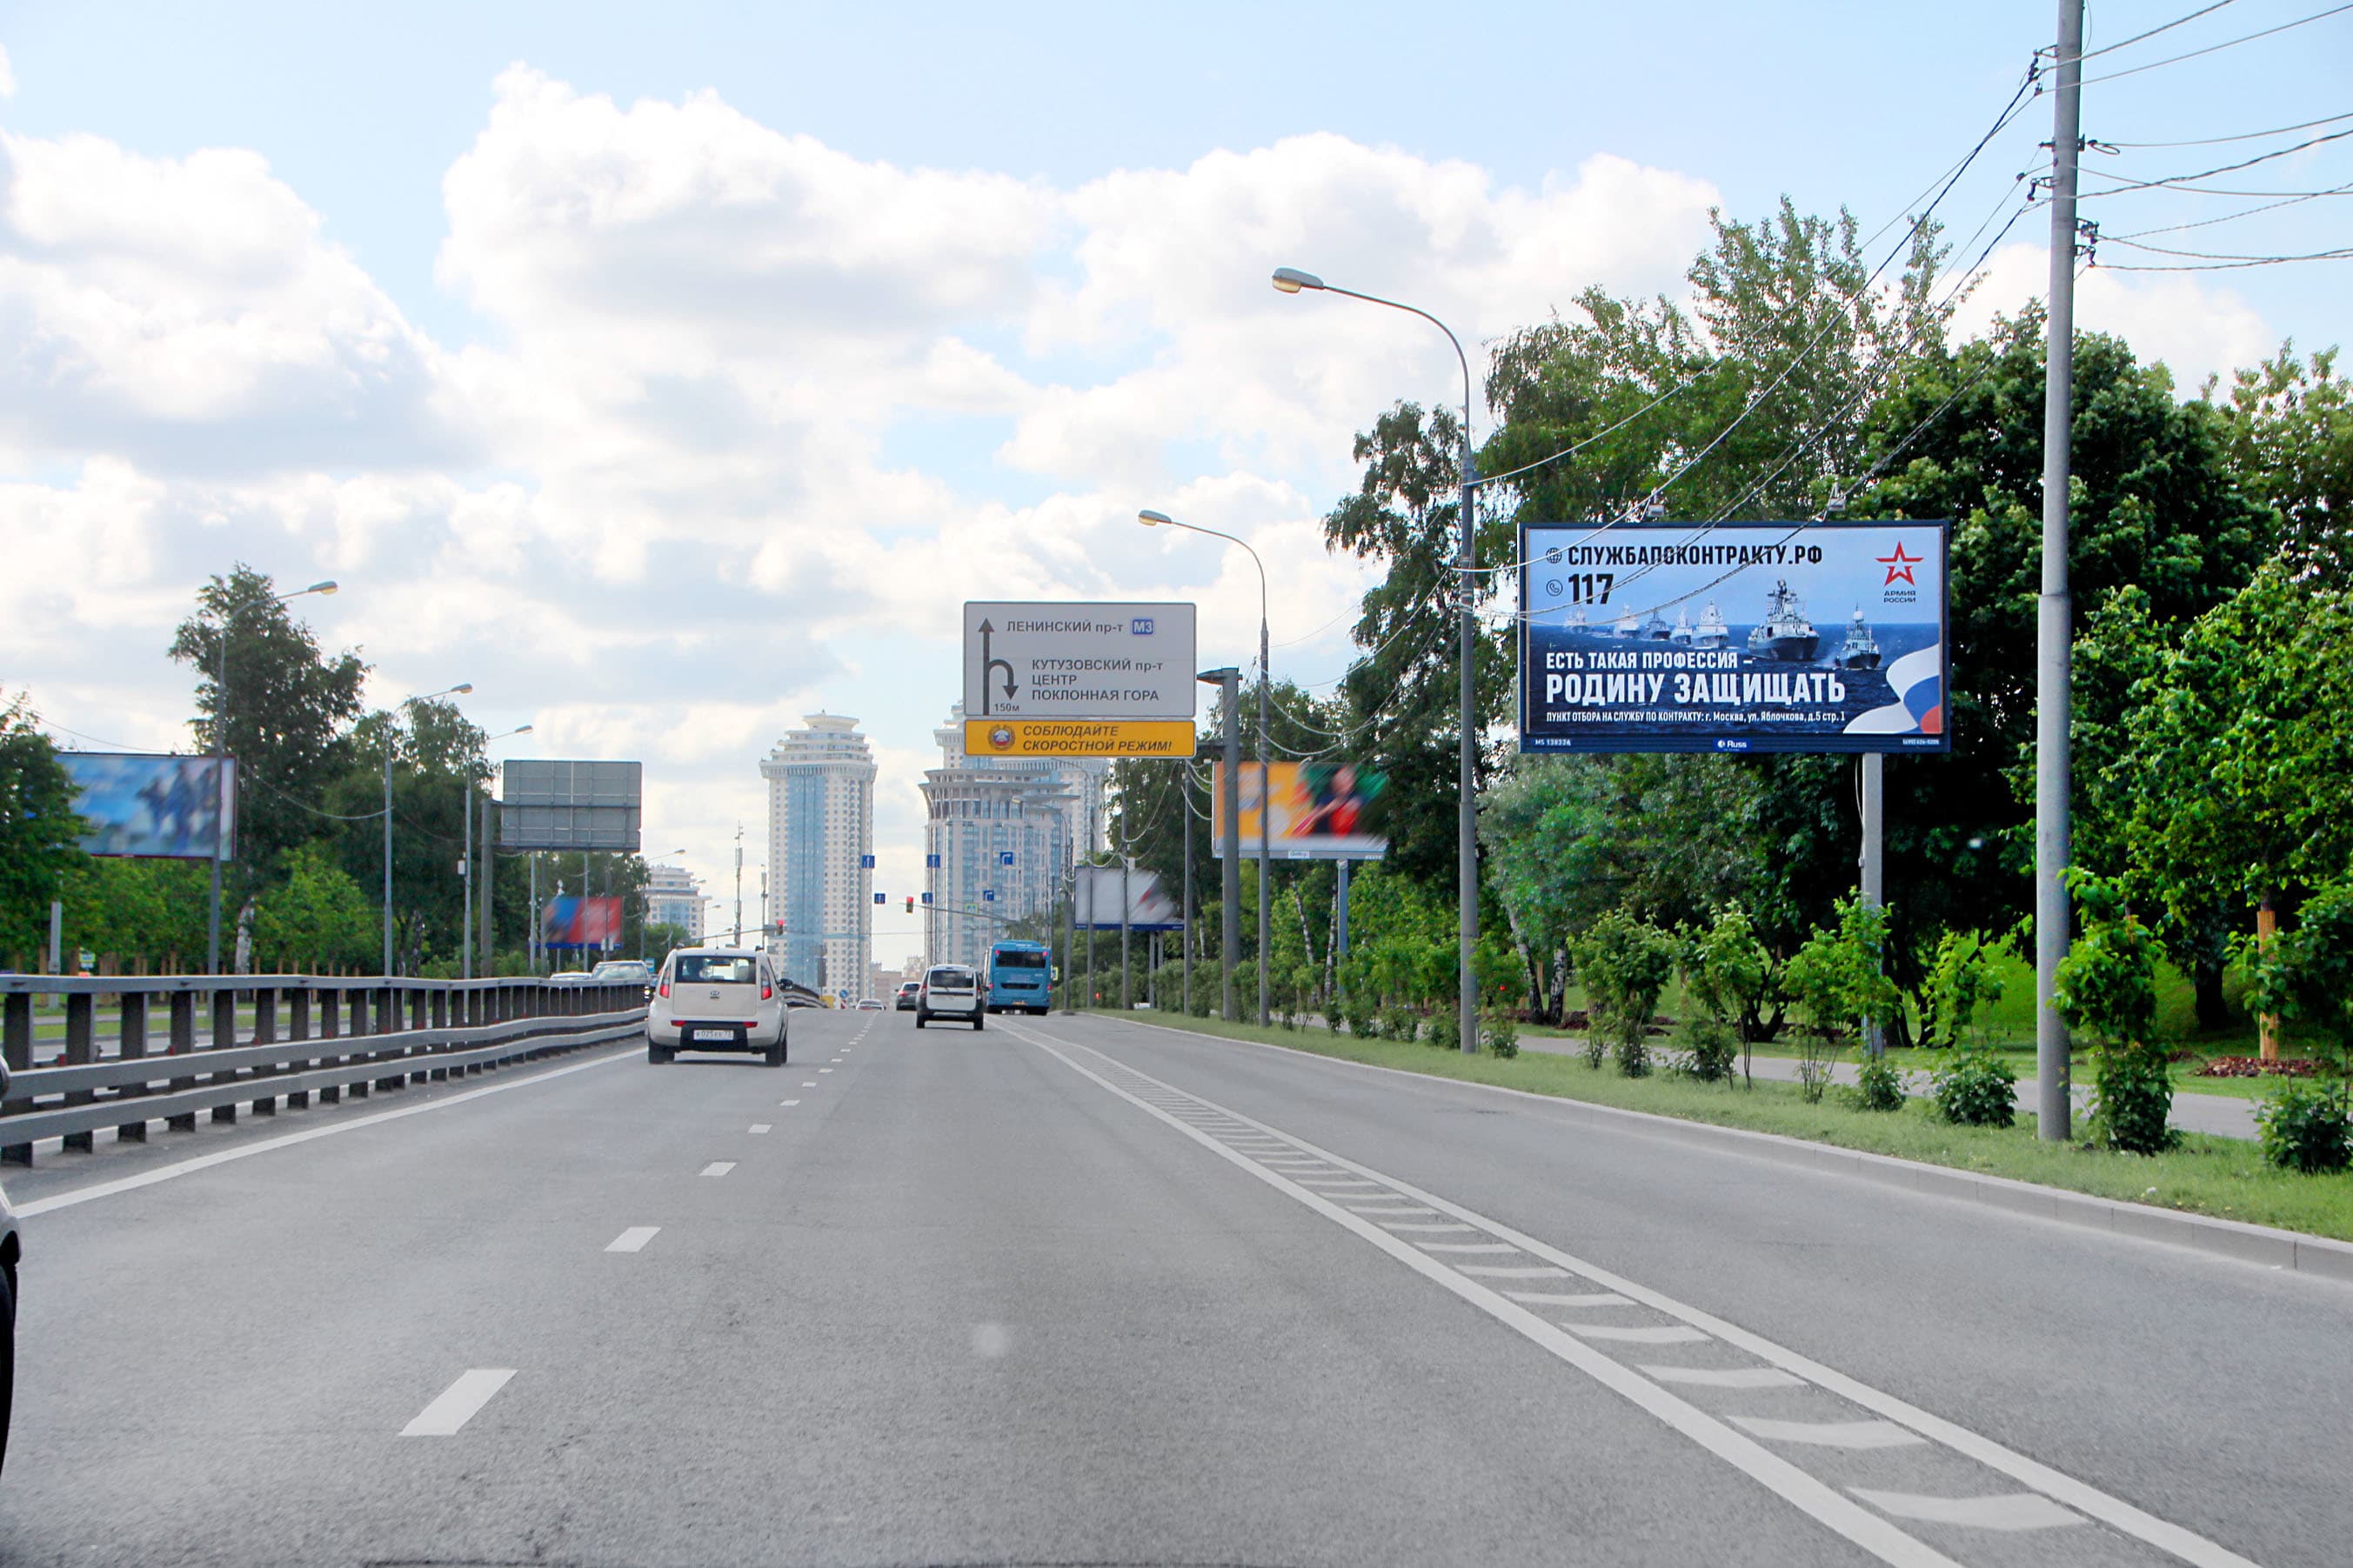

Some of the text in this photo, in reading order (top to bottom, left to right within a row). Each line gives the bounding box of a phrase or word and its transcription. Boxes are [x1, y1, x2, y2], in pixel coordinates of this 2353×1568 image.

[1568, 544, 1823, 565] СЛУЖБАПОКОНТРАКТУ.РФ
[1568, 573, 1614, 605] 117
[1006, 619, 1124, 635] ЛЕНИНСКИЙ пр-т
[1032, 657, 1163, 672] КУТУЗОВСКИЙ пр-т
[1546, 652, 1584, 669] ЕСТЬ
[1588, 652, 1637, 669] ТАКАЯ
[1642, 652, 1738, 669] ПРОФЕССИЯ
[1032, 674, 1077, 687] ЦЕНТР
[1032, 690, 1160, 701] ПОКЛОННАЯ ГОРА
[1546, 673, 1846, 706] РОДИНУ ЗАЩИЩАТЬ
[994, 703, 1019, 712] 150м
[1546, 711, 1571, 723] ПУНКТ
[1572, 711, 1601, 723] ОТБОРА
[1602, 711, 1613, 723] НА
[1614, 711, 1644, 723] СЛУЖБУ
[1645, 711, 1656, 723] ПО
[1658, 711, 1704, 723] КОНТРАКТУ:
[1713, 711, 1747, 724] Москва,
[1748, 712, 1760, 724] ул.
[1761, 711, 1808, 724] Яблочкова,
[1808, 711, 1821, 724] д.5
[1822, 713, 1839, 724] стр.
[1841, 711, 1845, 722] 1
[1023, 724, 1120, 737] СОБЛЮДАЙТЕ
[1023, 739, 1173, 751] СКОРОСТНОЙ РЕЖИМ!
[1728, 740, 1748, 749] Russ
